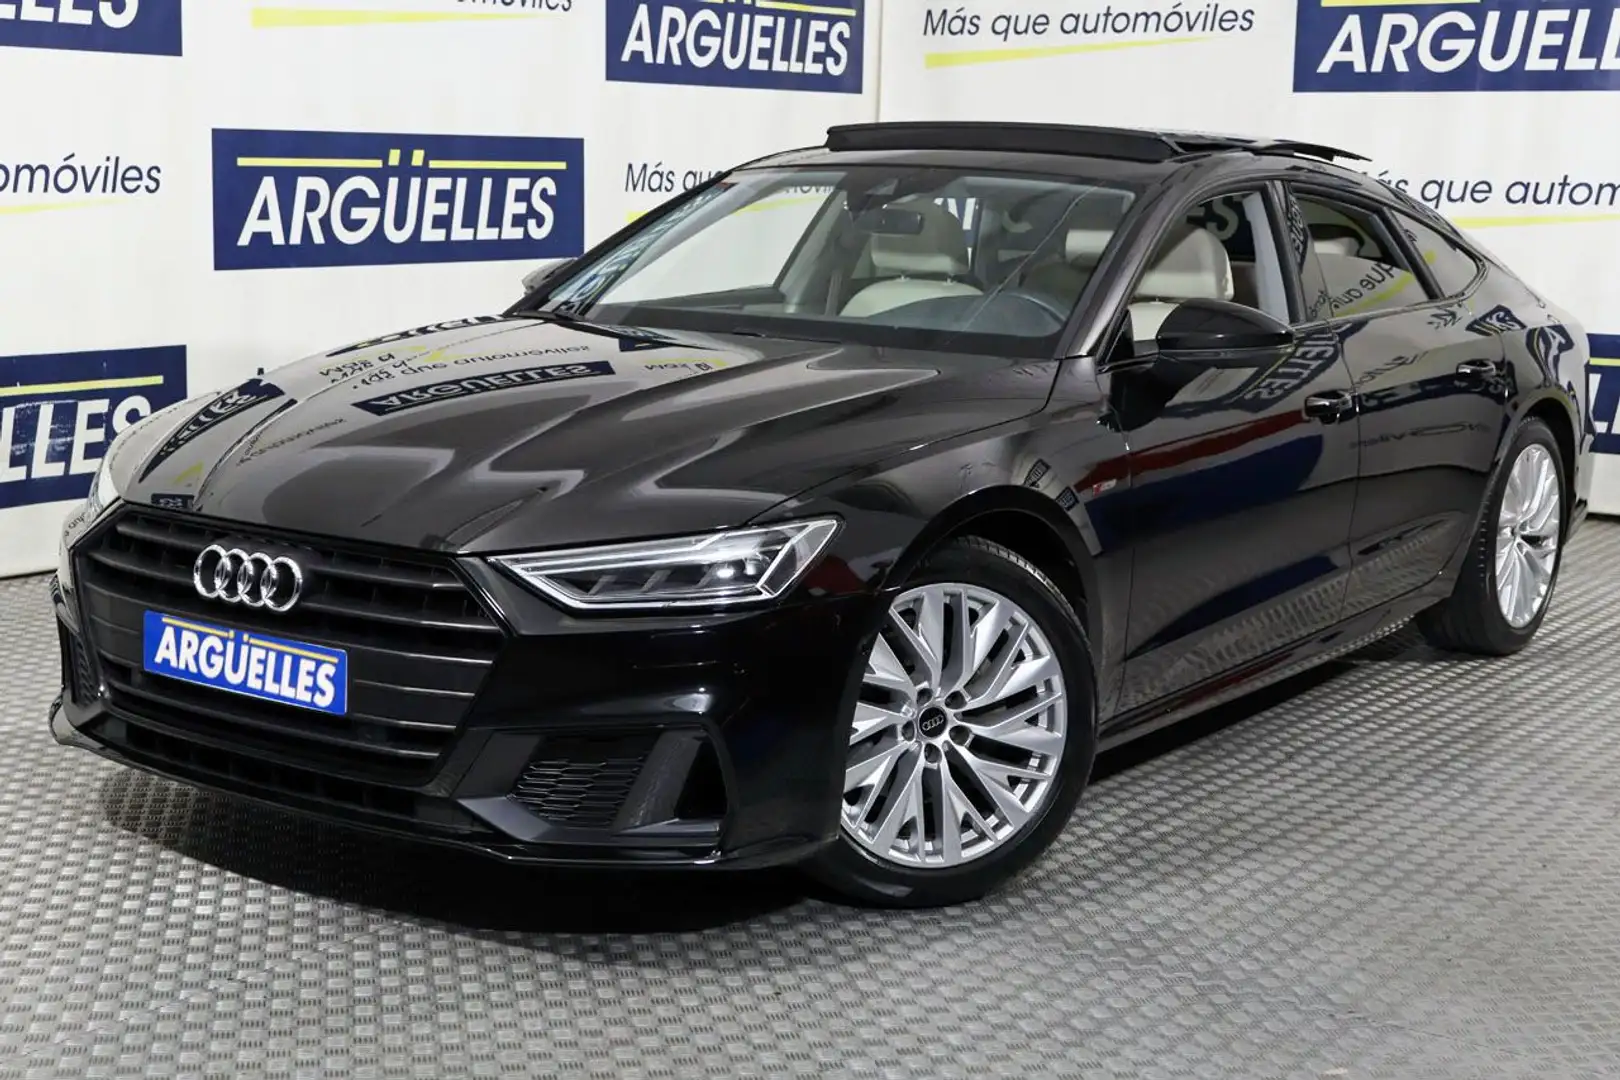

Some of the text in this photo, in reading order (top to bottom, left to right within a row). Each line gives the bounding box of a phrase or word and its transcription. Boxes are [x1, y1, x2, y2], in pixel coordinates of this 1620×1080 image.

[923, 3, 1255, 41] Más que automóviles
[625, 161, 675, 193] Más
[1420, 179, 1492, 209] que
[237, 149, 557, 246] ARGÜELLES
[154, 626, 337, 708] ARGÜELLES
